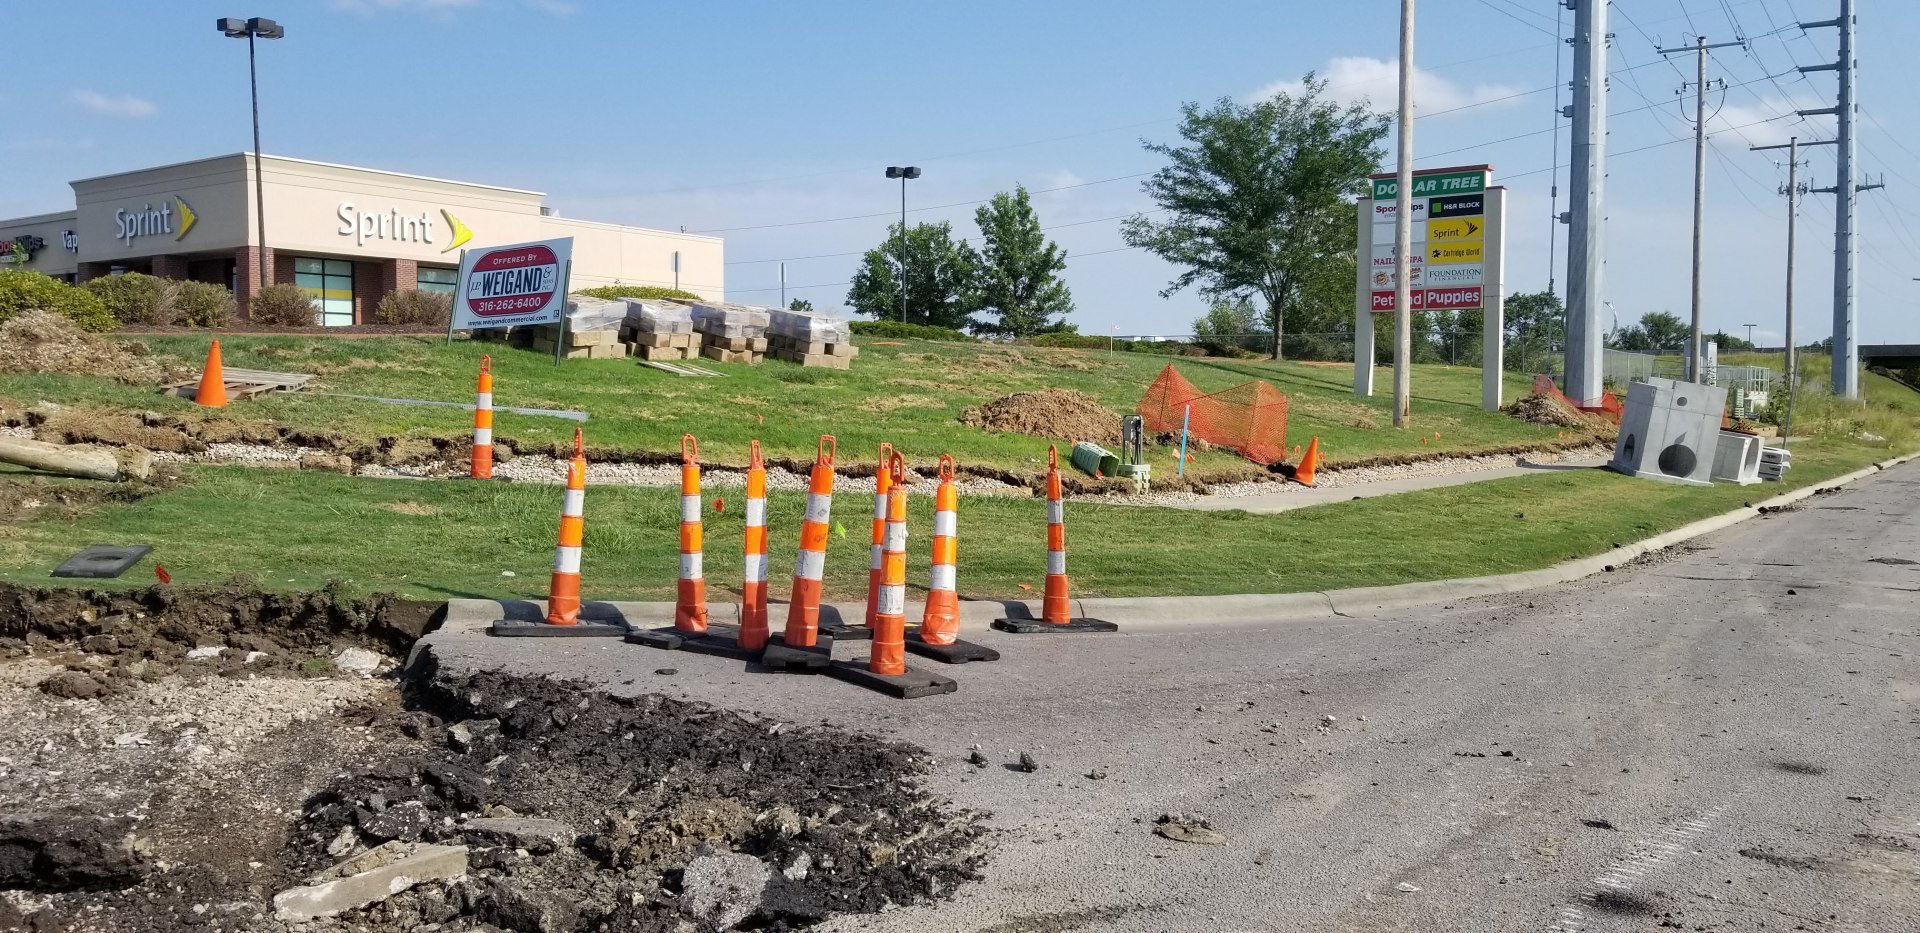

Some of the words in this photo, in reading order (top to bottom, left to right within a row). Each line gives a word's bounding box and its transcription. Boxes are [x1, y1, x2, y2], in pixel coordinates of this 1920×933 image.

[1377, 180, 1436, 195] DOAR
[1442, 176, 1480, 190] TREE
[1376, 205, 1396, 214] Spor
[1459, 201, 1480, 209] BLOCK
[116, 201, 170, 246] Sprint
[337, 202, 432, 247] Sprint
[1433, 229, 1459, 239] Sprint
[1466, 248, 1480, 256] World
[493, 255, 526, 265] OFFERED
[1429, 269, 1481, 278] FOUNDATION
[482, 267, 542, 297] WEIGAND
[543, 266, 552, 279] &
[1428, 291, 1480, 304] Puppies
[478, 297, 541, 312] 316-262-6400
[468, 315, 548, 327] www.weigandcommercial.com
